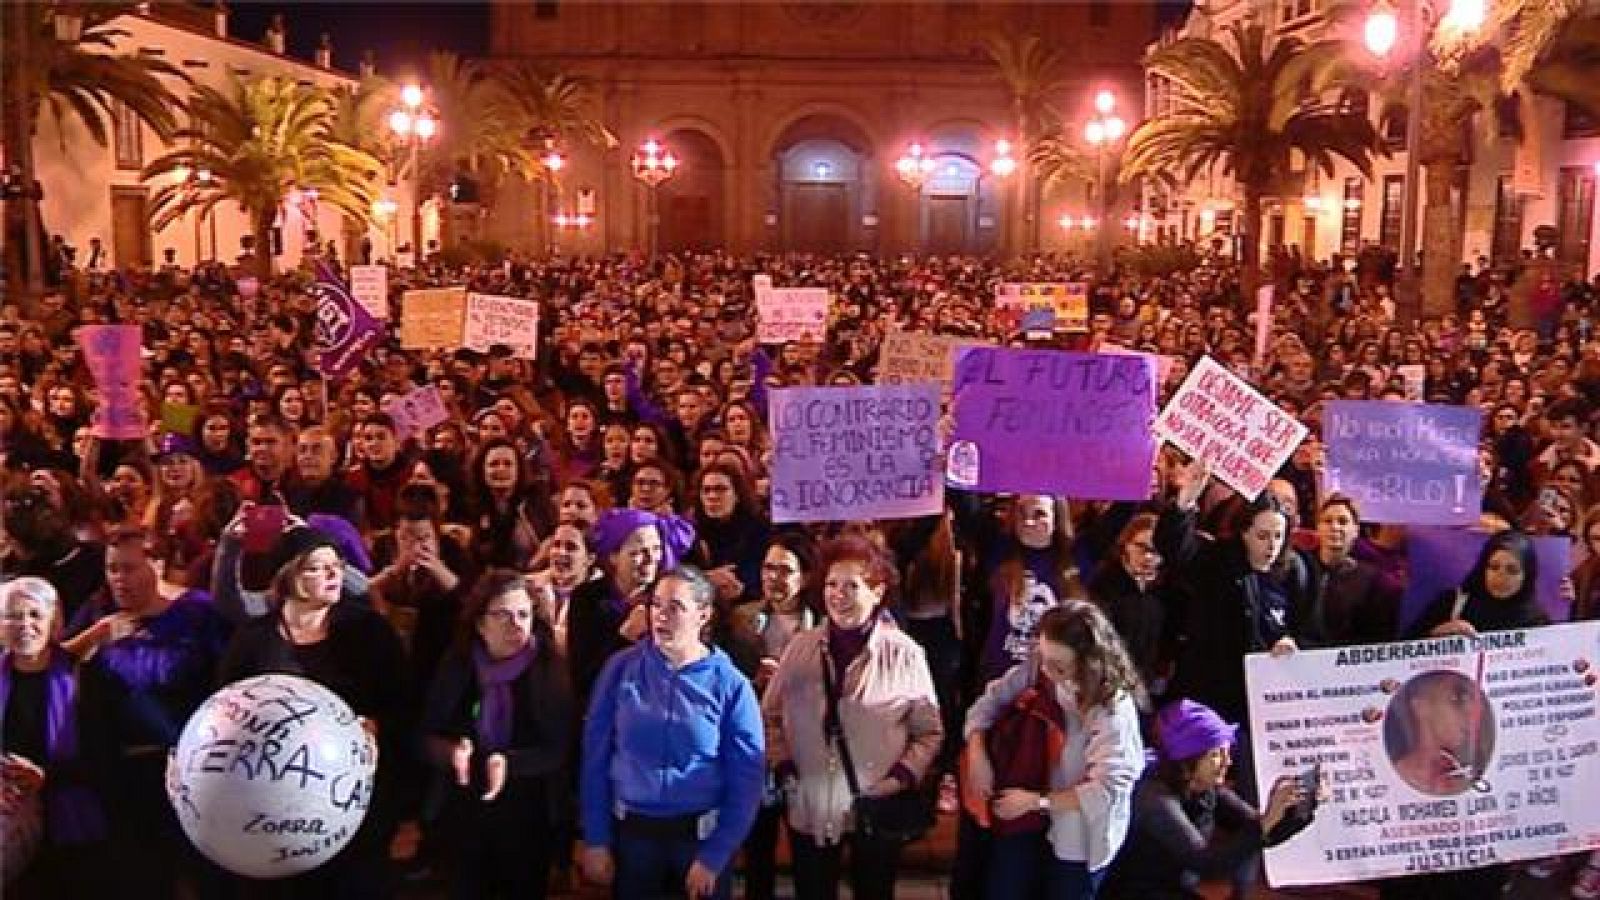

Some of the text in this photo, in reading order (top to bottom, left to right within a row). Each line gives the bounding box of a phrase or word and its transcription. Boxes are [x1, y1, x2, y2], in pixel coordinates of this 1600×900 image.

[1020, 353, 1151, 396] FUTURO
[775, 398, 931, 430] LO CONTRARIO
[824, 453, 896, 478] ES LA
[796, 474, 933, 511] IGNORANCIA
[1335, 632, 1526, 667] ABDERRAHIM DINAR
[1397, 799, 1458, 821] MOHAMED
[1507, 828, 1522, 842] LA
[1405, 846, 1497, 872] JUSTICIA
